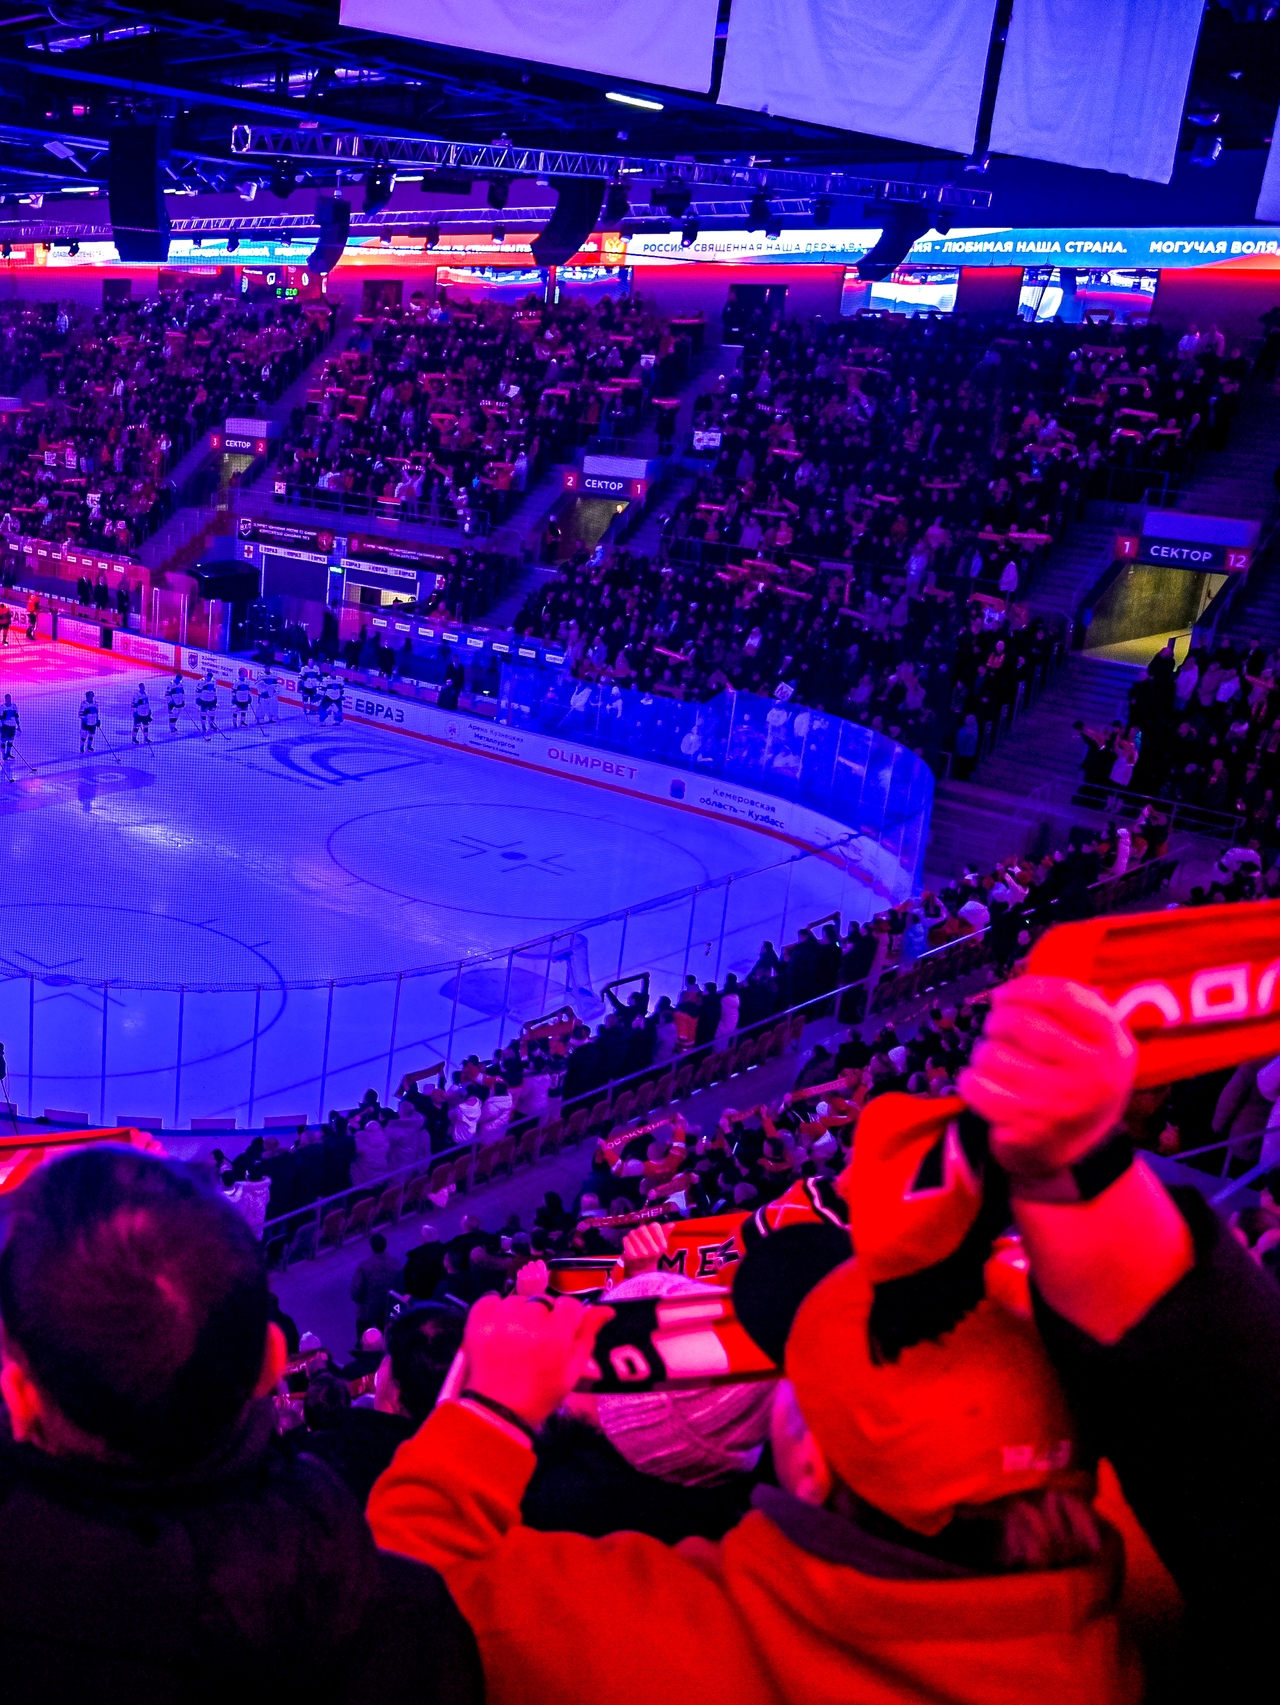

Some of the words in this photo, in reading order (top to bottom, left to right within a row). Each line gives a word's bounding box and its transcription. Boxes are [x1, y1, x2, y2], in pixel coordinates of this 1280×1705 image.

[643, 243, 684, 253] РОССИЯ
[693, 243, 763, 253] СВЯЩЕННАЯ
[766, 243, 801, 252] НАША
[942, 241, 1014, 253] ЛЮБИМАЯ
[1017, 241, 1061, 253] НАША
[1065, 241, 1128, 253] СТРАНА.
[1149, 241, 1227, 254] МОГУЧАЯ
[1230, 241, 1280, 256] ВОЛЯ,
[225, 439, 251, 449] СЕКТОР
[567, 476, 574, 486] 2
[585, 479, 623, 491] СЕКТОР
[1124, 541, 1131, 553] 1
[1150, 545, 1213, 562] СЕКТОР
[1229, 553, 1247, 568] 12
[355, 698, 404, 723] ЕВРАЗ
[548, 747, 638, 780] OLIMPBET
[712, 787, 776, 813] Кемеровская
[699, 796, 738, 814] область
[747, 809, 785, 830] Кузбасс
